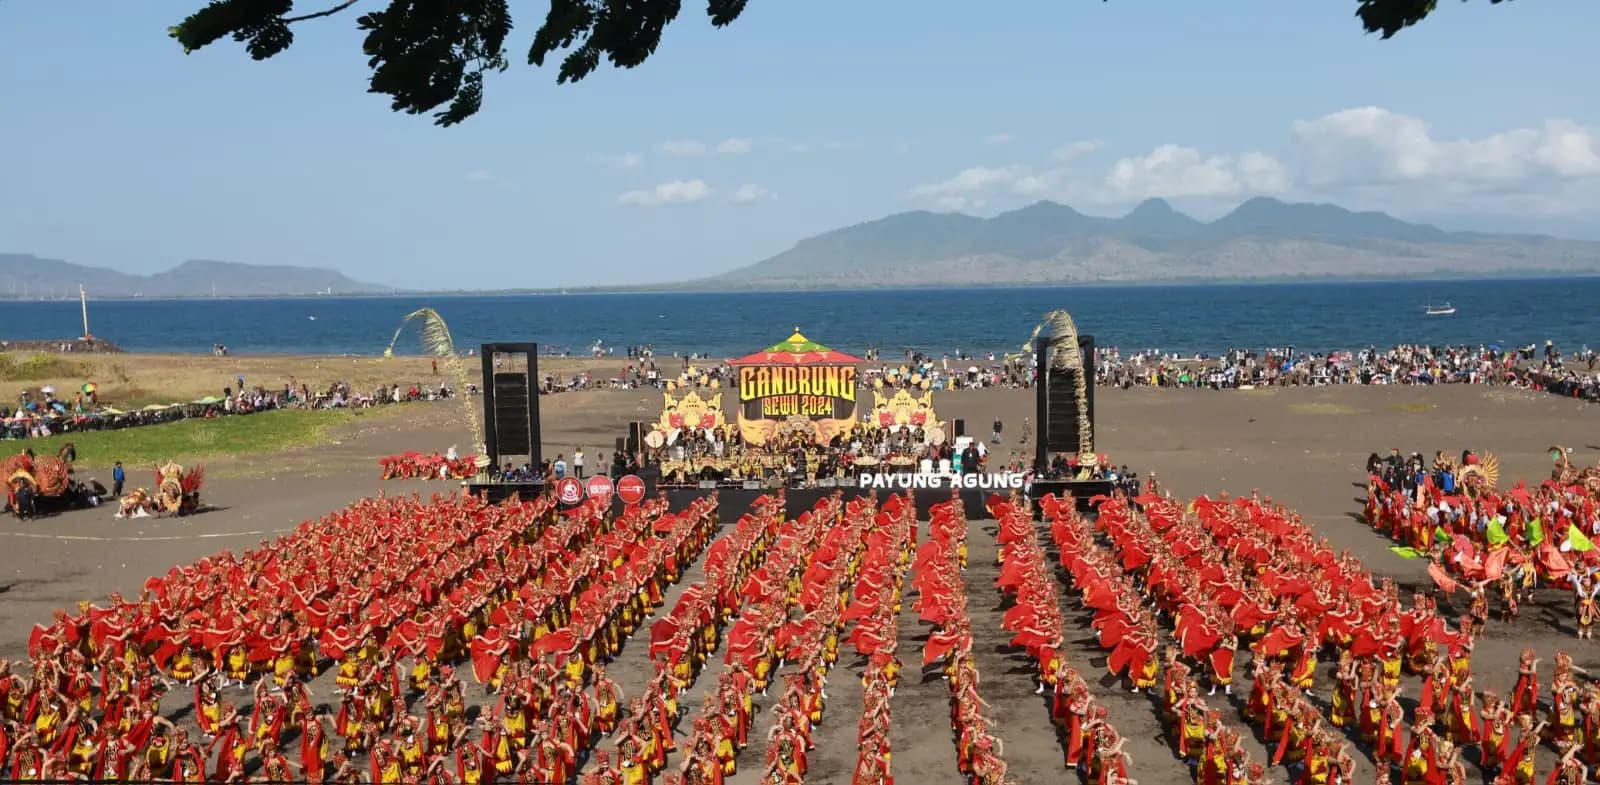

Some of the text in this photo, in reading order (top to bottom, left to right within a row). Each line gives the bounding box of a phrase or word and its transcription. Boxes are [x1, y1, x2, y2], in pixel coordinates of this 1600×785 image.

[740, 366, 856, 402] GANDRUNG
[764, 395, 832, 416] SEWU 2024
[860, 472, 1023, 488] PAYUNG AGUNG
